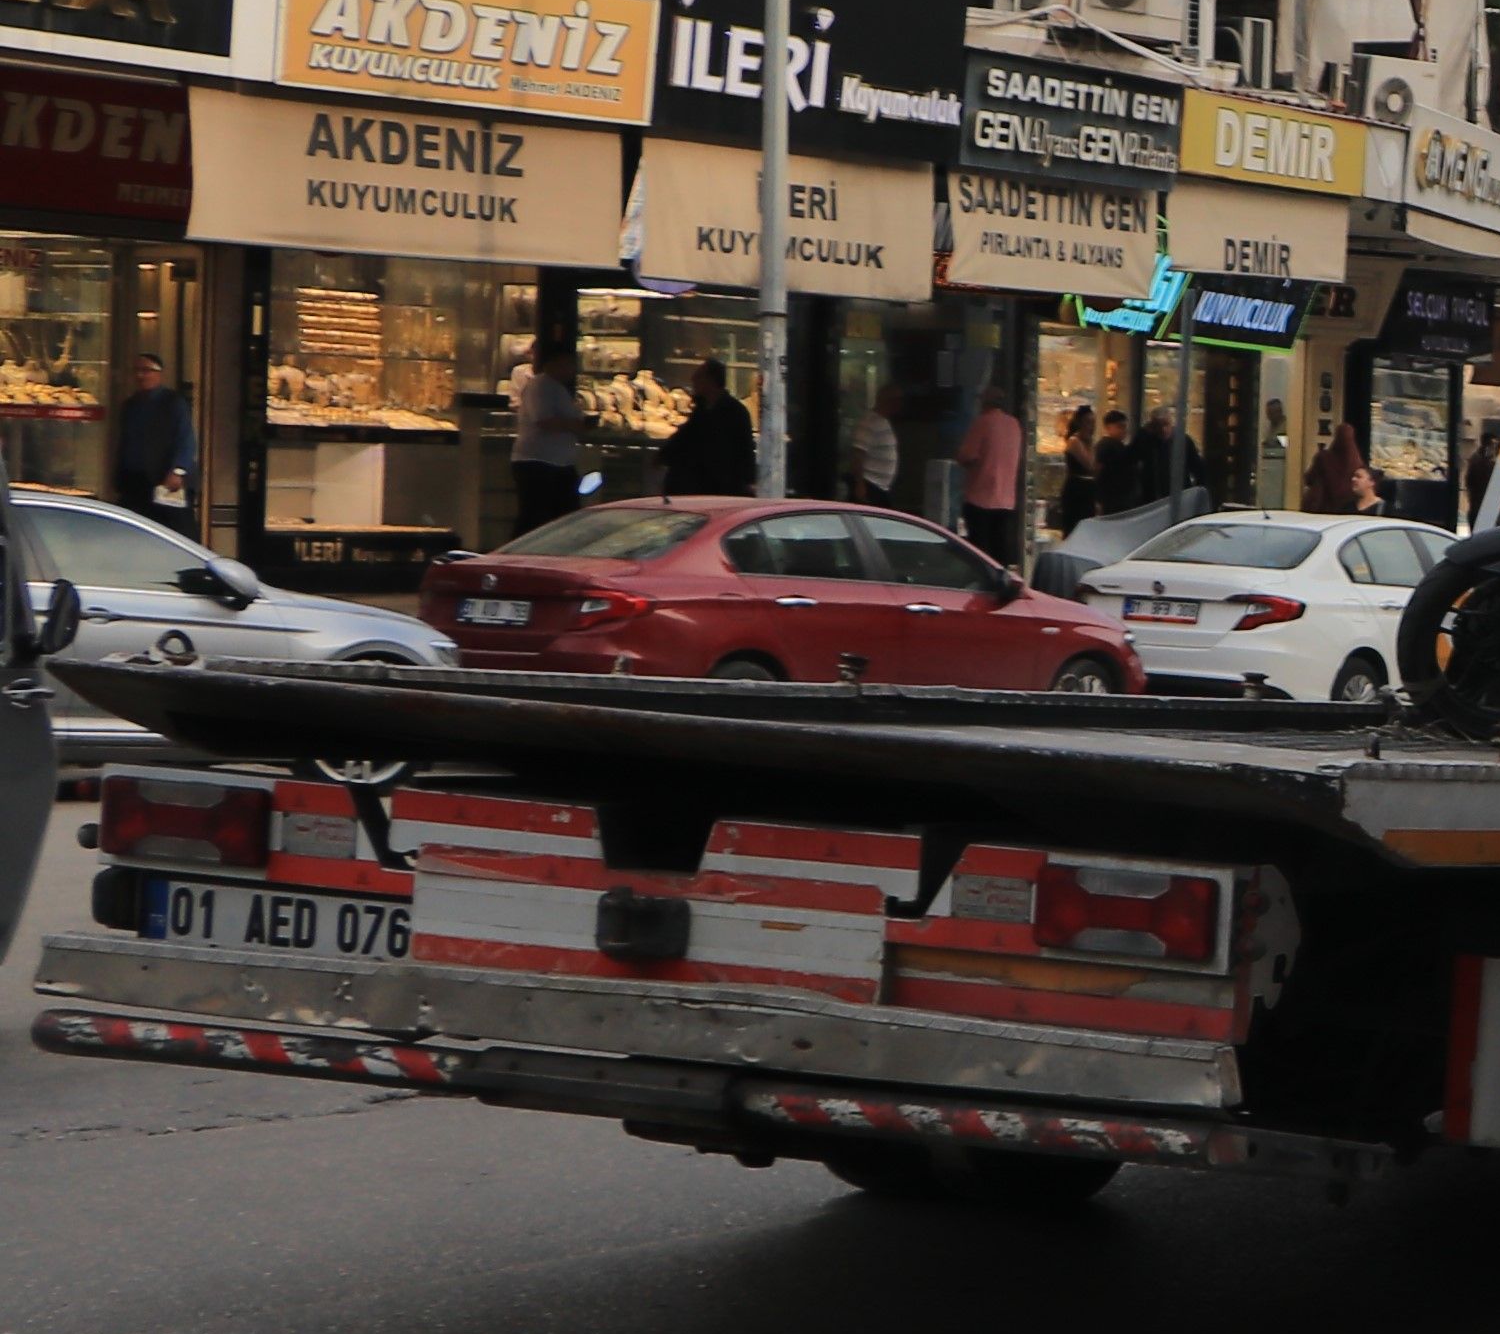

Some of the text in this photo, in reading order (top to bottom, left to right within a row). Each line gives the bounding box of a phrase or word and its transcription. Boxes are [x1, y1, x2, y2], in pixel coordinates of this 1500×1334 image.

[307, 43, 501, 91] KUYUMCULUK
[1131, 94, 1179, 125] GEN
[1214, 106, 1336, 183] DEMİR
[306, 178, 519, 223] KUYUMCULUK
[756, 171, 838, 222] ERİ
[1101, 192, 1148, 234] GEN
[696, 225, 885, 270] KUYMCULUK
[979, 232, 1051, 262] PIRLANTA
[1071, 241, 1124, 269] ALYANS
[1224, 234, 1292, 277] DEMİR
[171, 887, 412, 958] 01 AED 076
